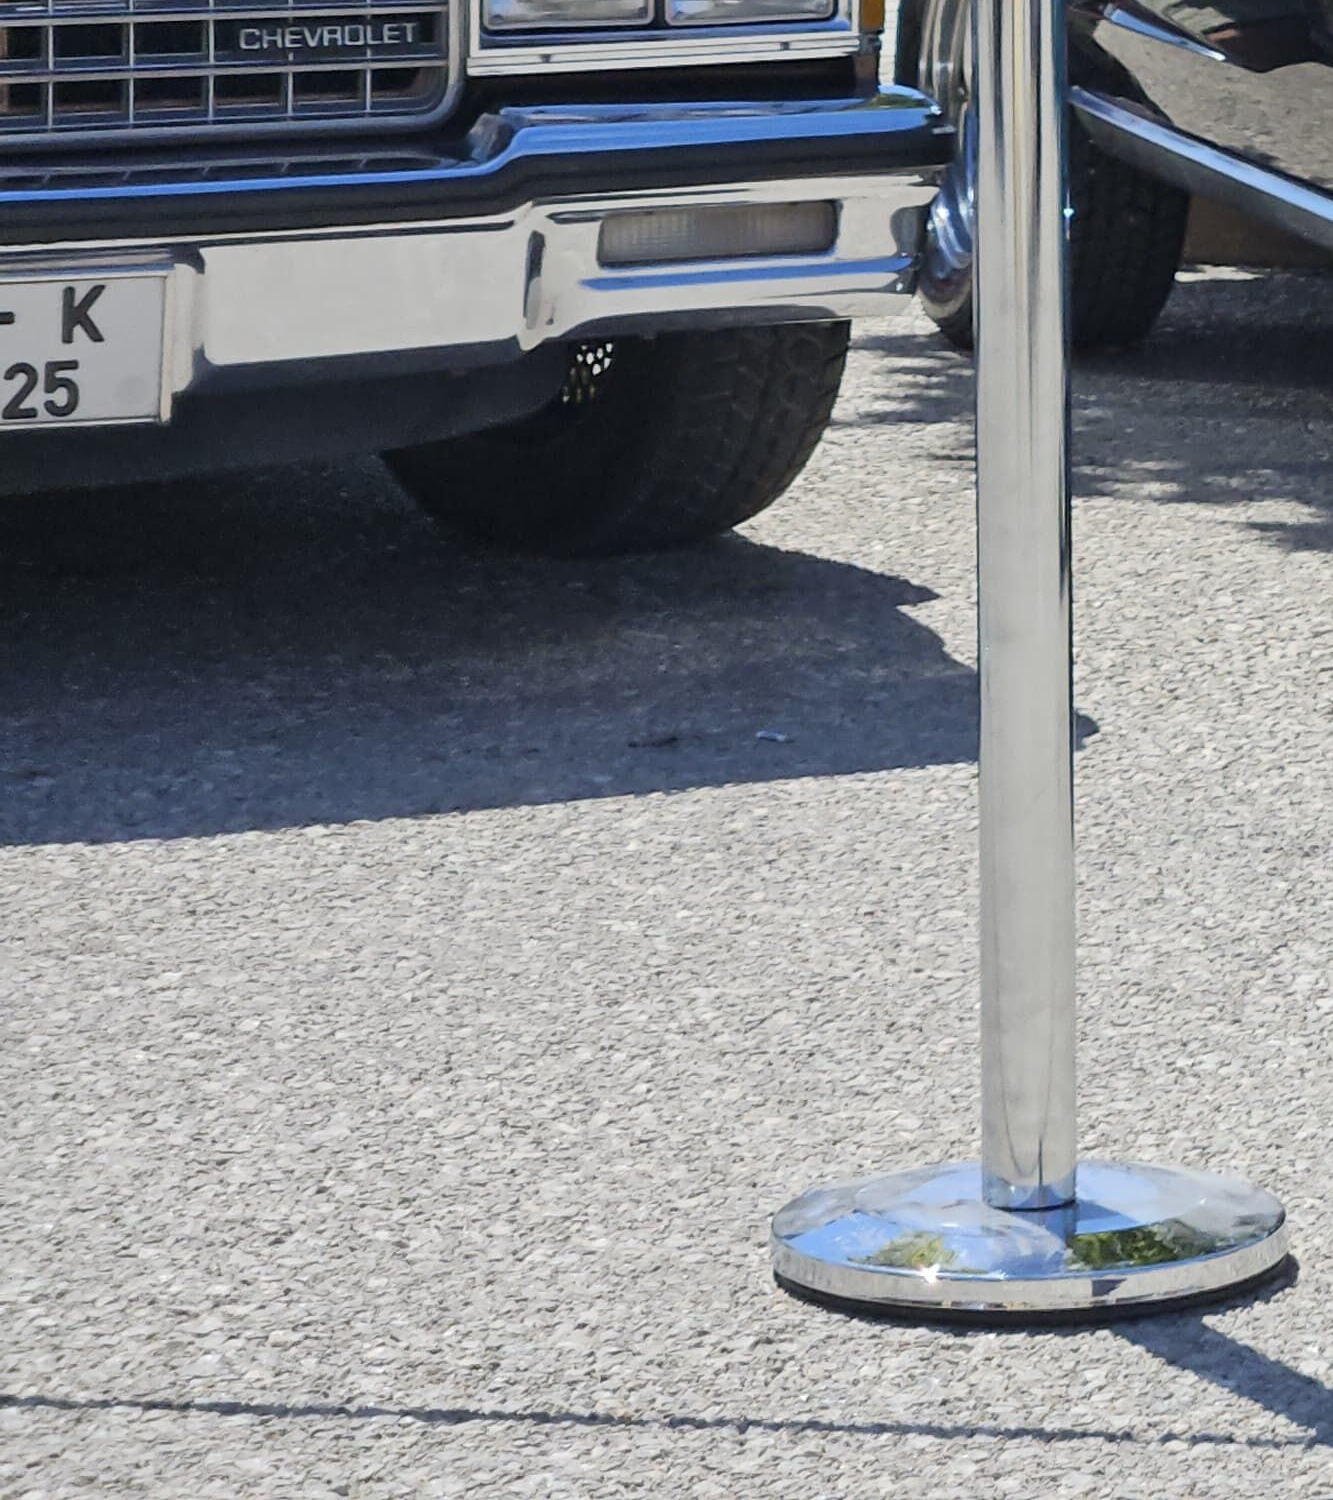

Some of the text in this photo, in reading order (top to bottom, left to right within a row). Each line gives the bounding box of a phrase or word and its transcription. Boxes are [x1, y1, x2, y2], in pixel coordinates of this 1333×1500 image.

[238, 21, 418, 51] CHEVROLET
[61, 284, 107, 344] K
[2, 359, 79, 420] 25
